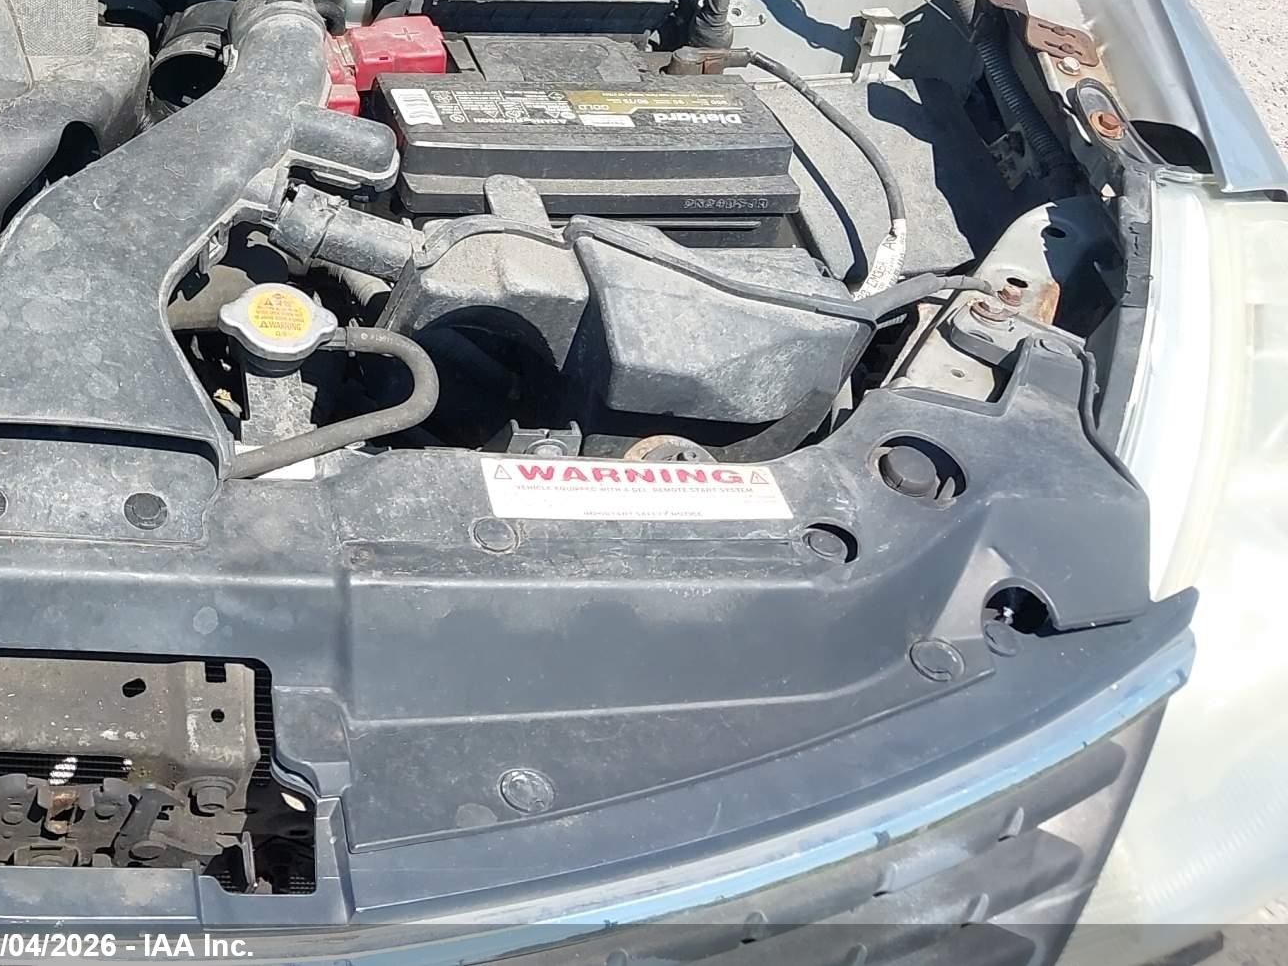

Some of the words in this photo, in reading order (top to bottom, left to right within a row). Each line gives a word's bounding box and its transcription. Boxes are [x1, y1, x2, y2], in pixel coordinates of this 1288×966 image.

[653, 112, 742, 125] DieHard
[268, 321, 302, 332] WARNING
[516, 464, 744, 484] WARNING
